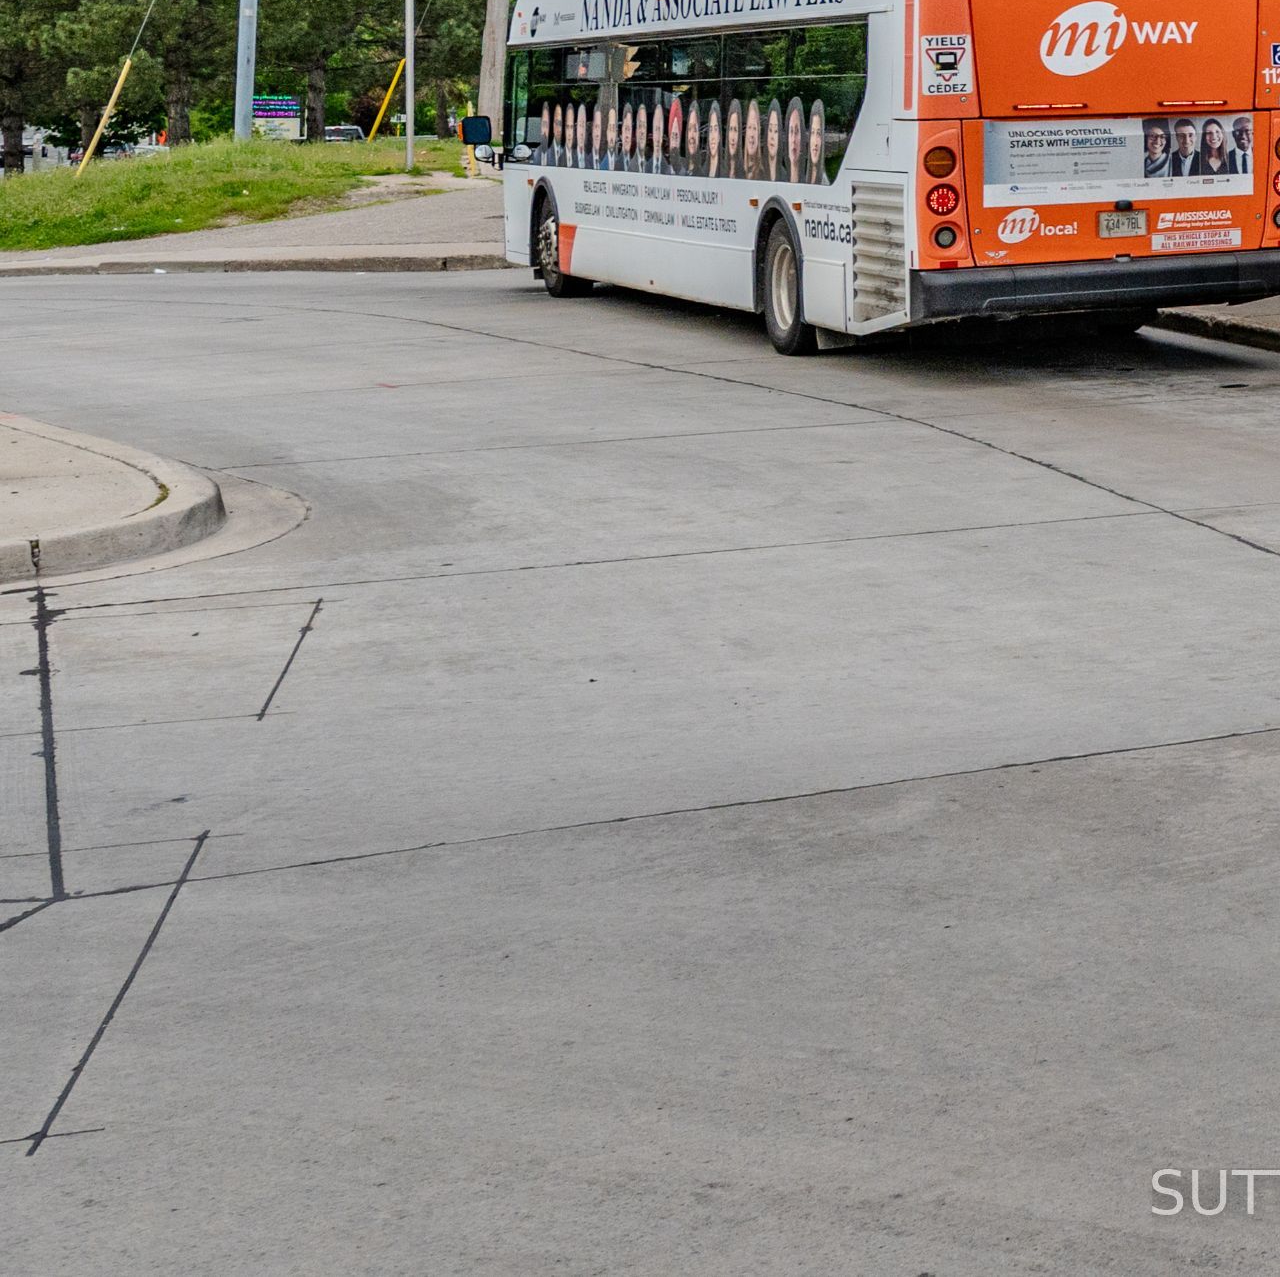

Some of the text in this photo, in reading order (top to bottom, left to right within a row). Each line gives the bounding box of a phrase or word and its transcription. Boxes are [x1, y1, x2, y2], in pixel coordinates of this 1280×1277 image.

[1131, 21, 1198, 44] WAY
[925, 37, 966, 46] YIELD
[928, 82, 967, 93] CÉDEZ
[1008, 128, 1113, 138] UNLOCKING POTENTIAL
[1010, 137, 1126, 149] STARTS WITH EMPLOYERS!
[1175, 209, 1232, 221] MISSISSAUGA
[804, 213, 851, 243] nanda.ca
[1203, 231, 1221, 239] STOPS
[1223, 230, 1231, 238] AT
[1173, 240, 1198, 248] RAILWAY
[1200, 238, 1233, 246] CROSSINGS
